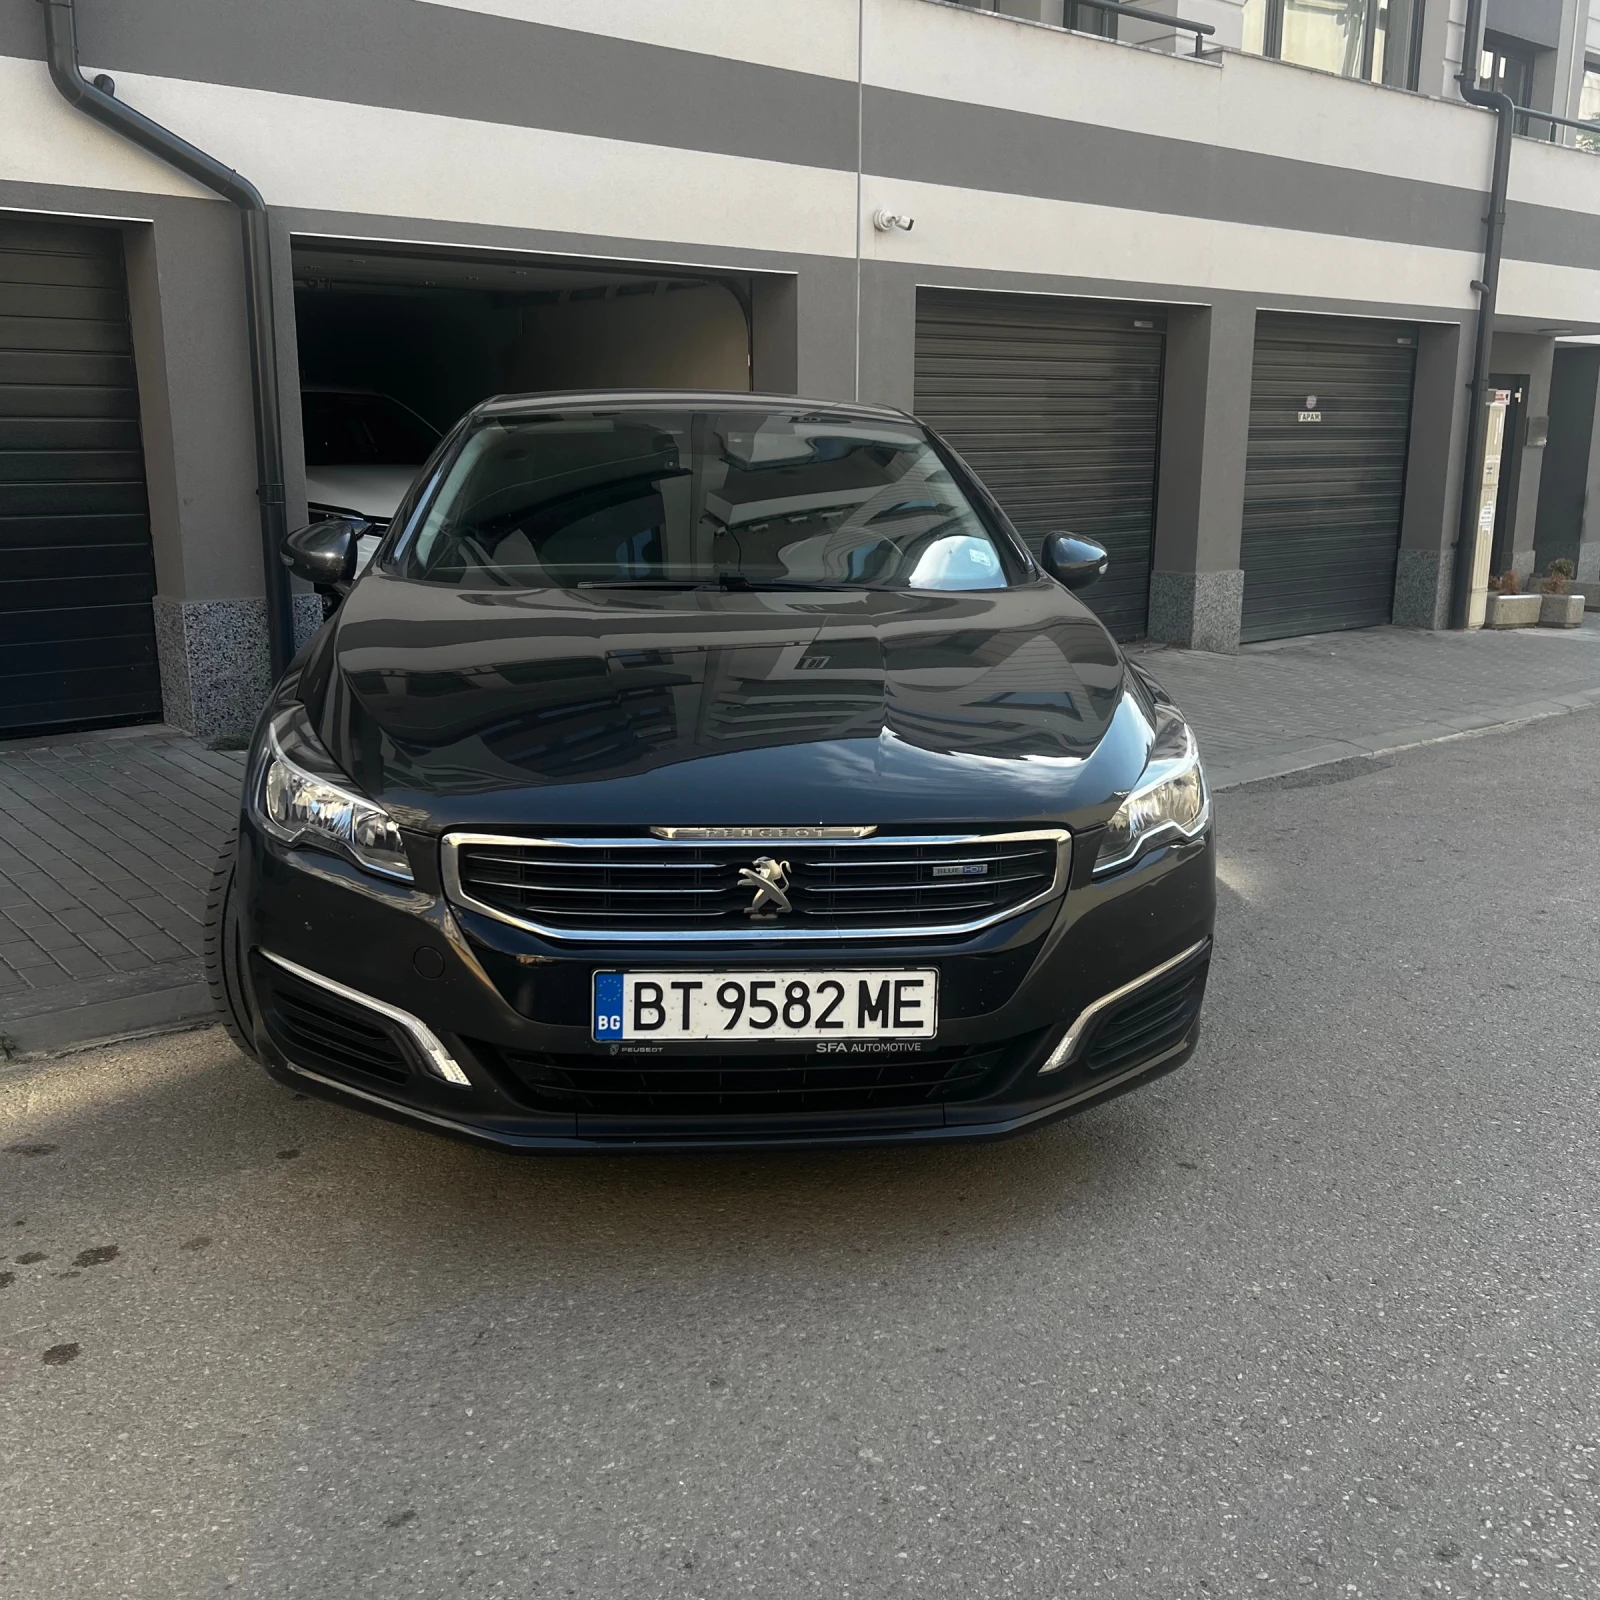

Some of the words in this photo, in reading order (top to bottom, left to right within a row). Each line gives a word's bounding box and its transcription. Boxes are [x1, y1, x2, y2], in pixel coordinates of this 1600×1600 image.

[705, 828, 825, 837] PEUGEOT
[936, 867, 961, 875] BLUE
[633, 981, 703, 1031] BT
[716, 980, 845, 1030] 9582
[857, 979, 924, 1029] ME
[598, 1015, 620, 1030] BG
[816, 1043, 848, 1053] SFA
[851, 1042, 921, 1053] AUTOMOTIVE
